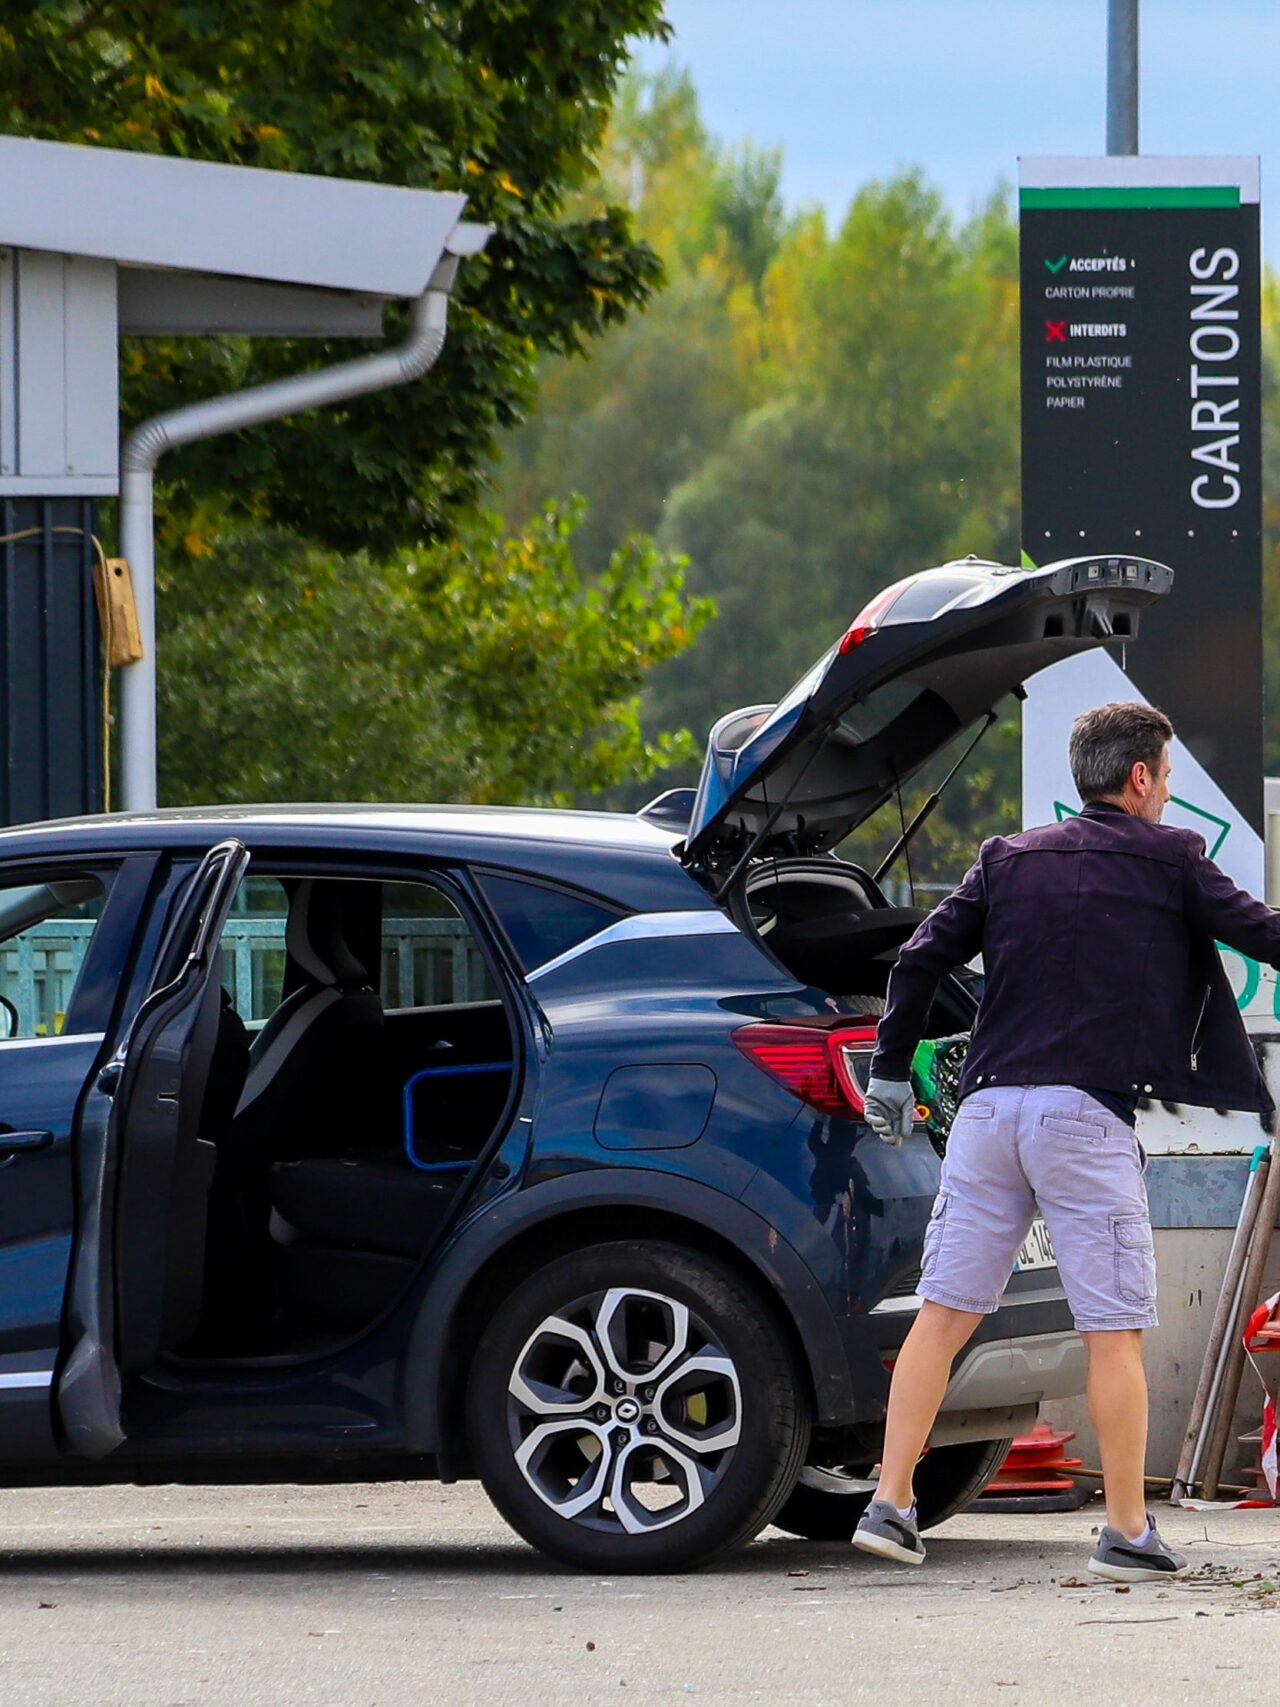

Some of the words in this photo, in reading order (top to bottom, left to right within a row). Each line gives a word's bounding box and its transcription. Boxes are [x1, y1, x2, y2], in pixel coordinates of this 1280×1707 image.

[1069, 256, 1126, 272] ACCEPTÉS
[1045, 286, 1089, 299] CARTON
[1092, 286, 1135, 299] PROPRE
[1070, 323, 1127, 337] INTERDITS
[1046, 356, 1072, 368] FILM
[1074, 356, 1132, 369] PLASTIQUE
[1189, 247, 1241, 509] CARTONS
[1046, 396, 1085, 409] PAPIER
